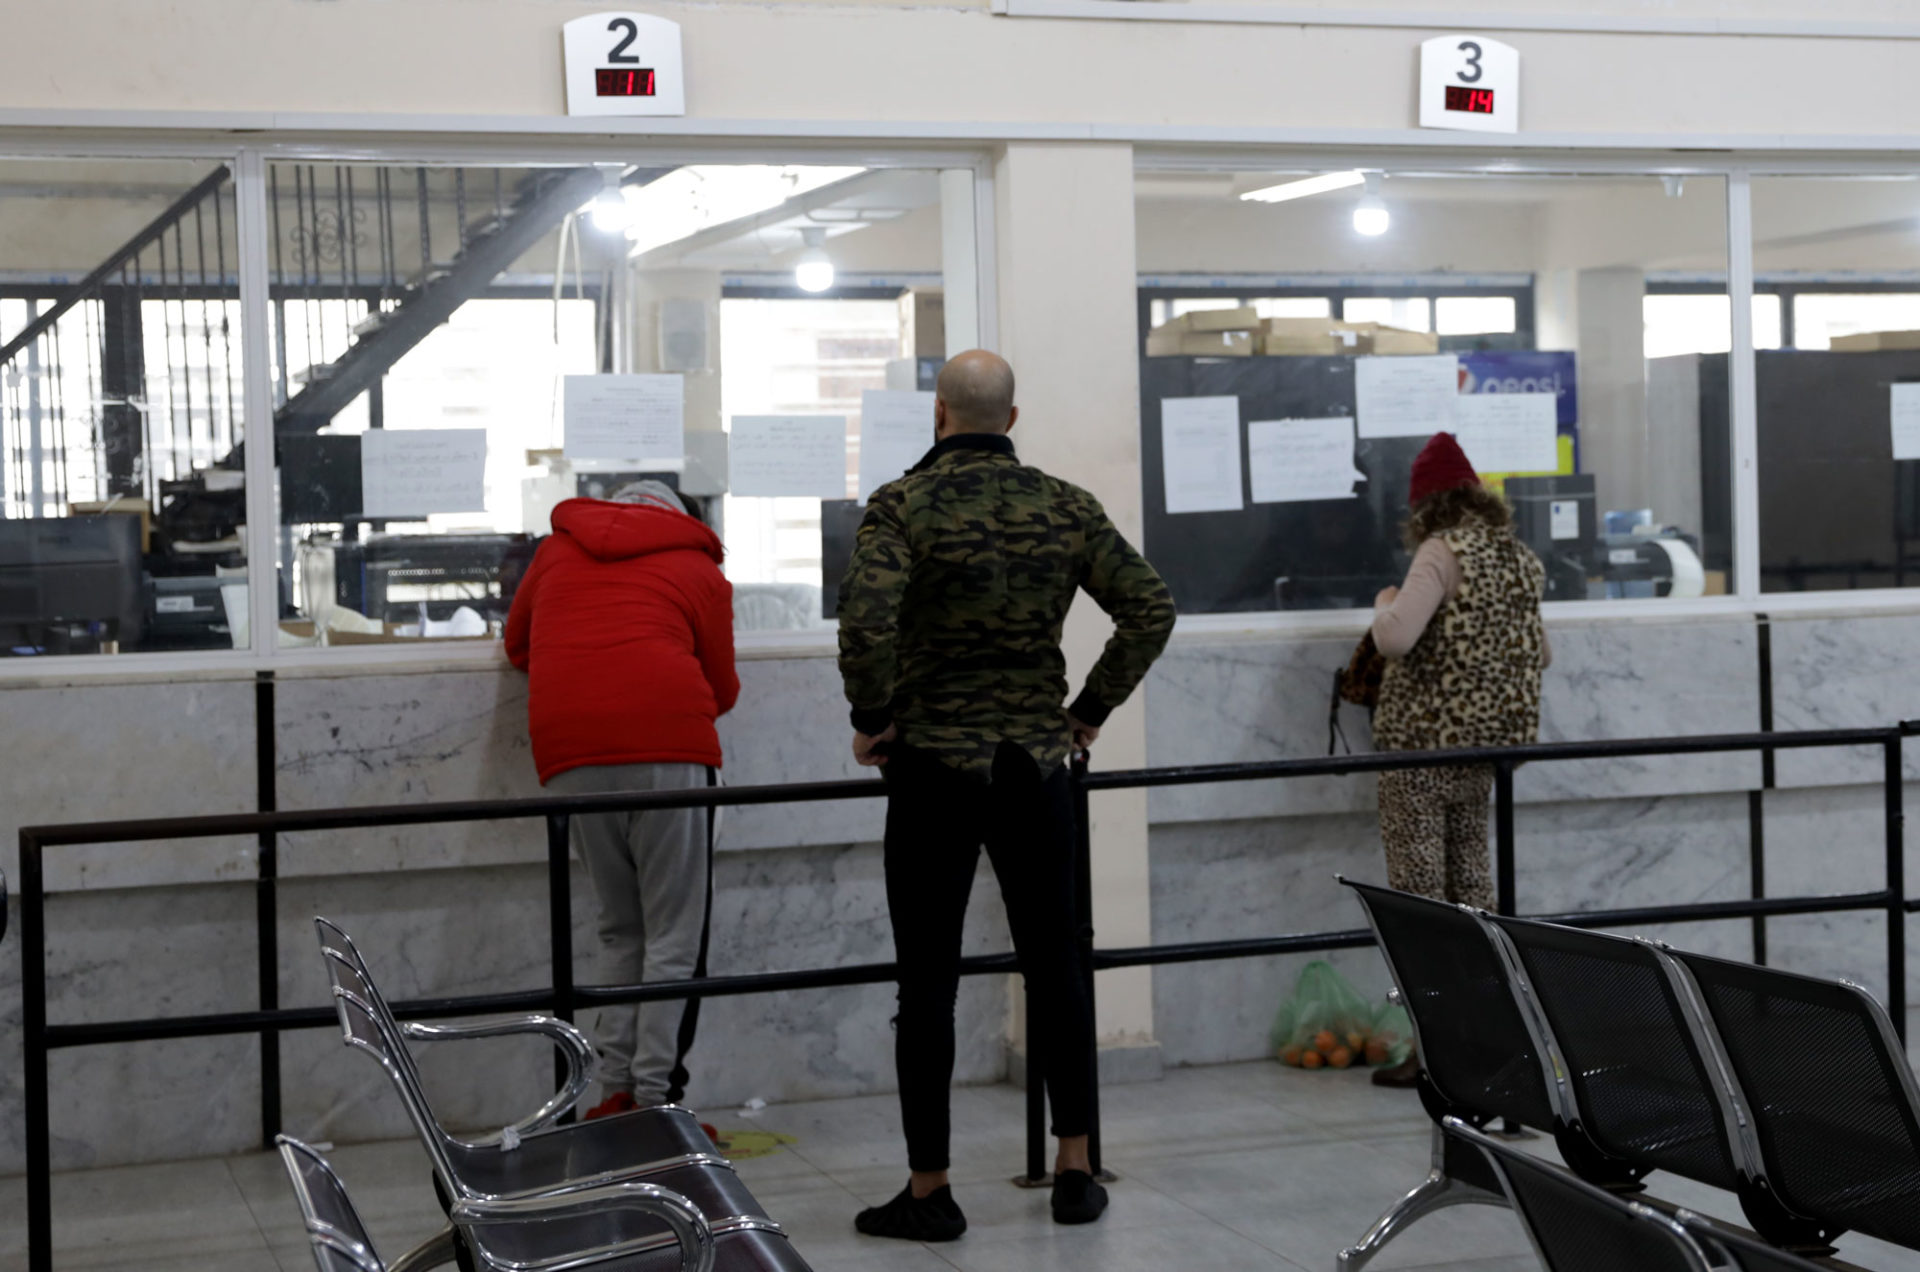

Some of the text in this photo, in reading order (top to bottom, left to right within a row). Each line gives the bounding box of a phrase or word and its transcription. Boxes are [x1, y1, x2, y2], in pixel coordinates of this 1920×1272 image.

[607, 17, 640, 64] 2
[1456, 41, 1483, 84] 3
[626, 71, 654, 95] 11
[1468, 90, 1494, 113] 14
